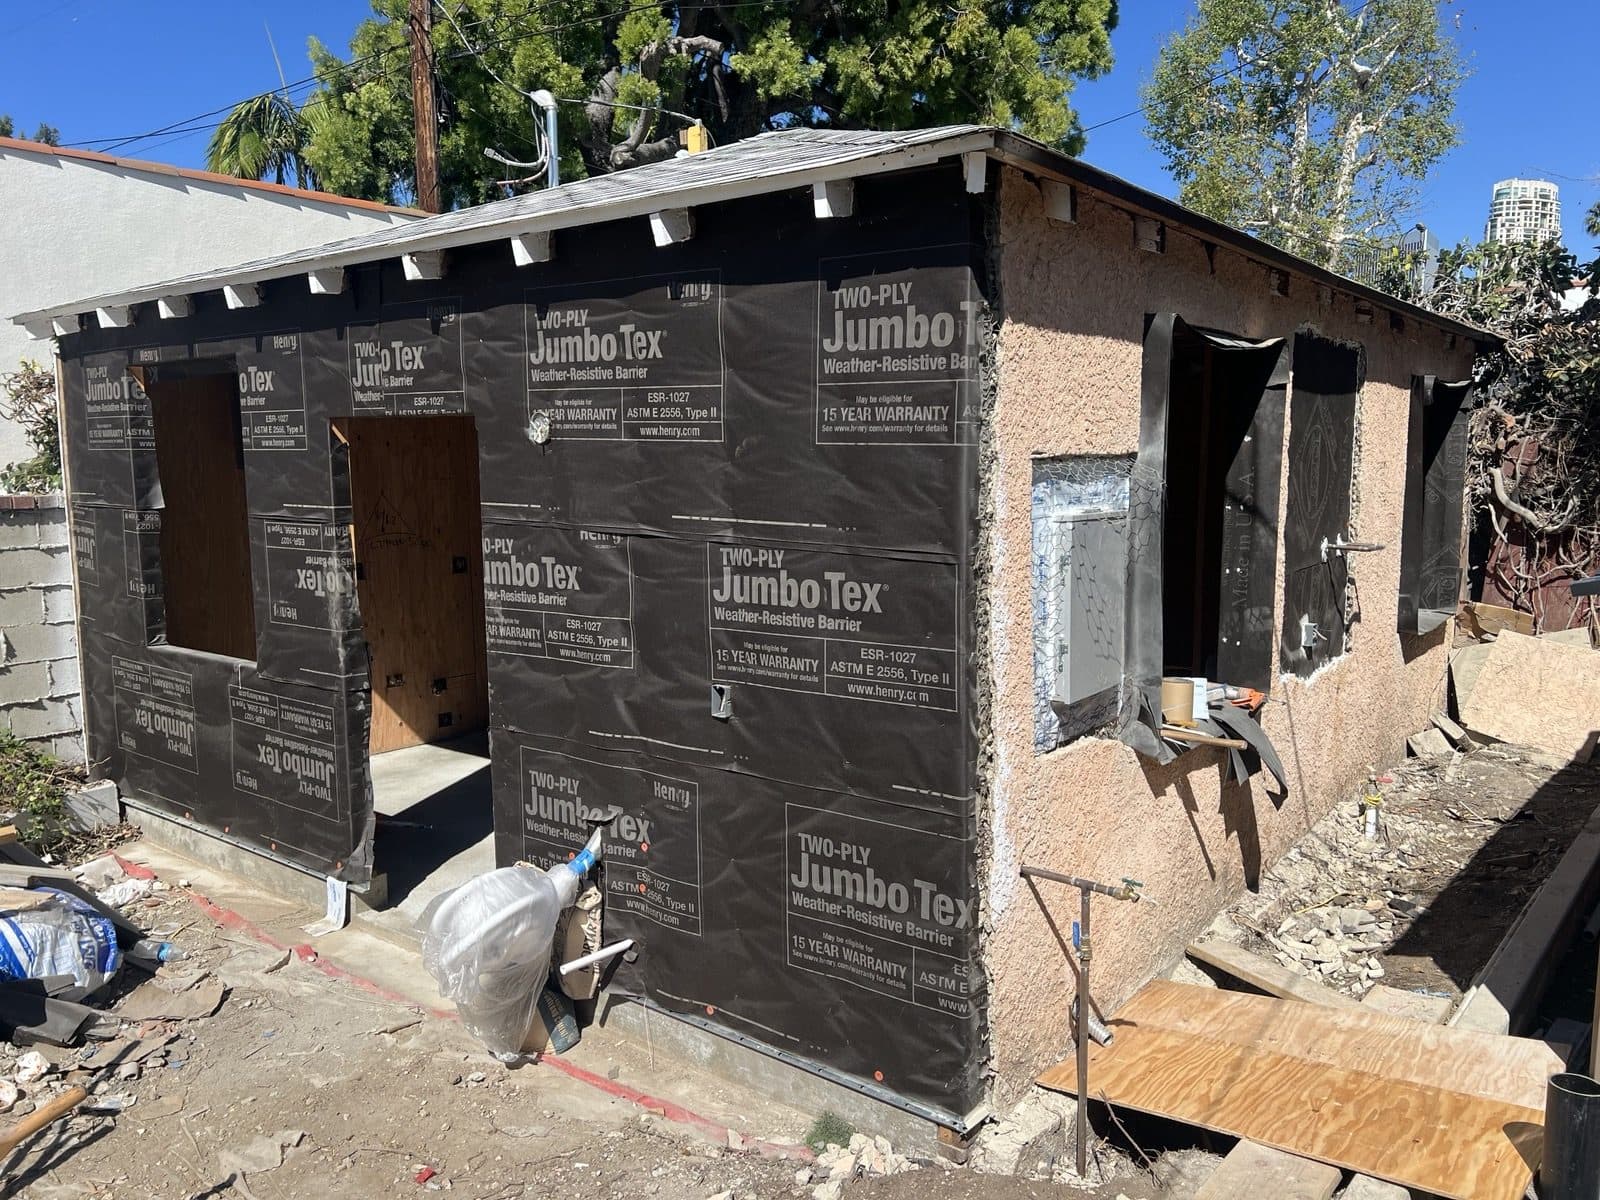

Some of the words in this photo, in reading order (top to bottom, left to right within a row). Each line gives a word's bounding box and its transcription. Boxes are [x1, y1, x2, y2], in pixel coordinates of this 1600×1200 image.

[832, 282, 912, 309] TWO-PLY
[823, 305, 954, 353] Jumbo
[273, 335, 297, 349] Henry
[530, 327, 617, 364] Jumbo
[531, 367, 613, 382] Weather-Resistive
[615, 366, 648, 380] Barrier
[823, 354, 946, 374] Weather-Resistive
[86, 378, 120, 401] Jumbo
[390, 375, 414, 386] Barrier
[414, 396, 444, 406] ESR-1027
[647, 392, 690, 403] ESR-1027
[567, 408, 617, 421] WARRANTY
[627, 408, 650, 418] ASTM
[652, 408, 658, 417] E
[660, 408, 683, 419] 2556,
[685, 407, 708, 420] Type
[823, 407, 837, 421] 15
[841, 407, 872, 421] YEAR
[875, 405, 949, 421] WARRANTY
[639, 426, 700, 438] www.henry.com
[915, 424, 923, 432] for
[720, 548, 784, 569] TWO-PLY
[713, 567, 821, 609] Jumbo
[538, 592, 567, 606] Barrier
[566, 619, 601, 631] ESR-1027
[714, 606, 815, 629] Weather-Resistive
[818, 615, 862, 632] Barrier
[499, 625, 541, 641] WARRANTY
[548, 630, 569, 641] ASTM
[570, 633, 575, 641] E
[597, 635, 619, 647] Type
[716, 649, 729, 662] 15
[731, 649, 757, 665] YEAR
[759, 653, 819, 673] WARRANTY
[860, 648, 916, 664] ESR-1027
[830, 662, 863, 676] ASTM
[866, 665, 873, 677] E
[876, 666, 908, 682] 2556,
[910, 669, 939, 685] Type
[135, 708, 154, 734] Tex
[280, 710, 310, 725] WARRANTY
[310, 717, 325, 728] YEAR
[154, 714, 194, 744] Jumbo
[167, 739, 193, 756] TWO-PLY
[257, 743, 282, 774] Tex
[281, 751, 334, 788] Jumbo
[236, 772, 258, 790] Henry
[298, 780, 332, 801] TWO-PLY
[529, 770, 580, 796] TWO-PLY
[654, 781, 691, 808] Henry
[798, 832, 871, 866] TWO-PLY
[636, 870, 670, 892] ESR-1027
[791, 853, 909, 914] Jumbo
[914, 878, 976, 930] Tex
[611, 881, 640, 893] ASTM
[665, 896, 686, 911] Type
[792, 891, 903, 933] Weather-Resistive
[906, 921, 954, 947] Barrier
[792, 935, 805, 949] 15
[808, 938, 839, 958] YEAR
[842, 946, 907, 979] WARRANTY
[919, 971, 956, 990] ASTM
[959, 981, 968, 994] E
